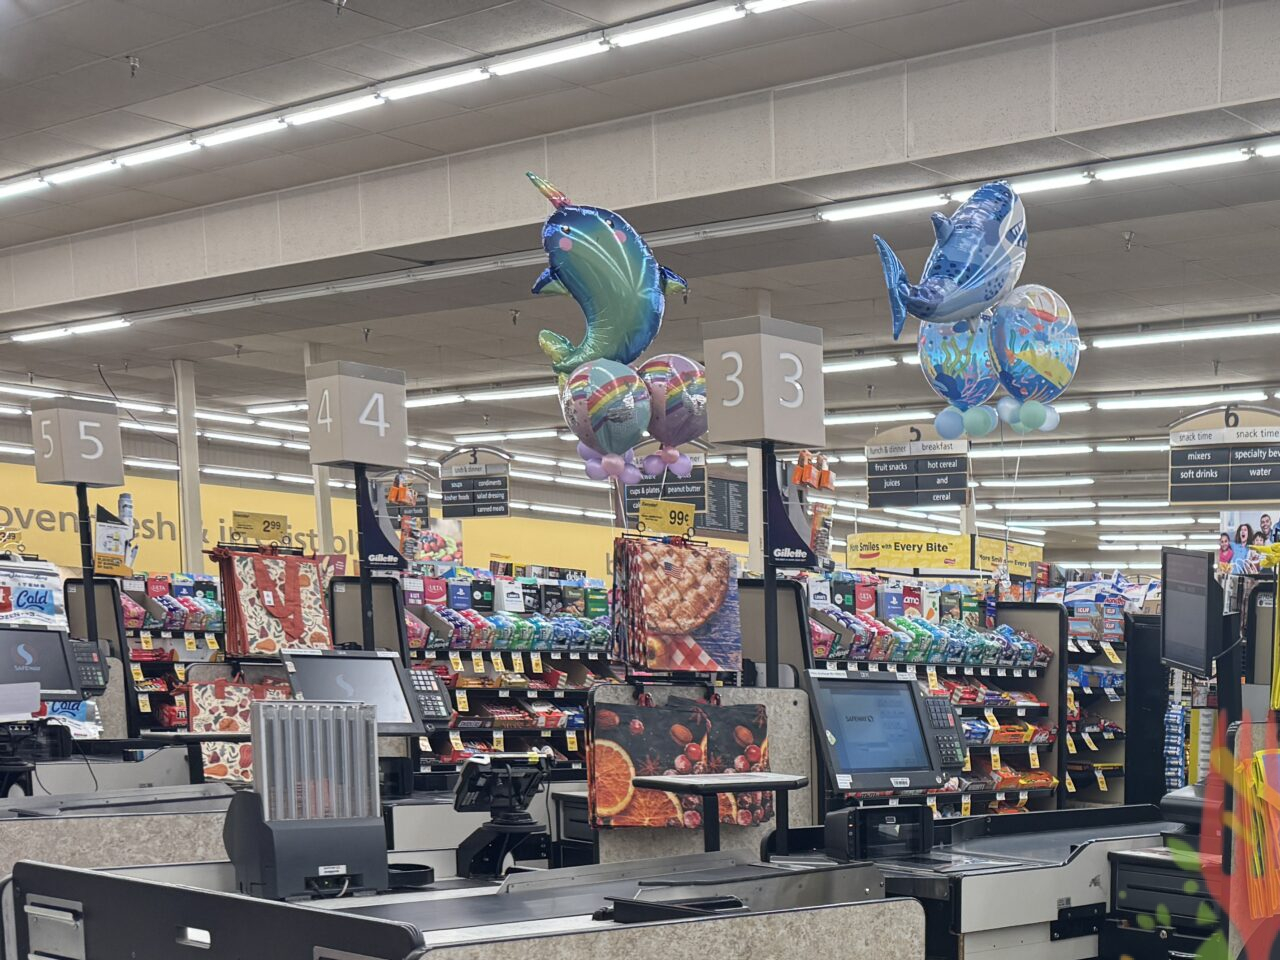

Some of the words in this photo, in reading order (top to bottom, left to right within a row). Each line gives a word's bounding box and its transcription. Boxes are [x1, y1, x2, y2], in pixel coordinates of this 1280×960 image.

[721, 351, 744, 407] 3
[778, 352, 804, 409] 3
[317, 389, 333, 433] 4
[358, 392, 391, 437] 4
[1224, 403, 1240, 428] 6
[1179, 433, 1195, 441] snack
[1197, 432, 1213, 440] time
[1236, 430, 1258, 439] snack
[1260, 429, 1280, 438] time
[41, 420, 54, 459] 5
[79, 421, 104, 460] 5
[1187, 452, 1211, 460] mixers
[1235, 449, 1266, 460] specialty
[875, 463, 888, 471] fruit
[928, 461, 938, 469] hot
[939, 460, 957, 468] cereal
[1180, 470, 1195, 479] soft
[1196, 469, 1218, 478] drinks
[1249, 468, 1272, 476] water
[884, 480, 901, 488] juices
[936, 476, 949, 484] and
[668, 486, 685, 494] peanut
[932, 493, 951, 501] cereal
[859, 542, 880, 551] Smiles
[894, 542, 923, 553] Every
[773, 548, 807, 558] Gillette
[16, 590, 48, 610] Cold
[904, 596, 920, 604] amc
